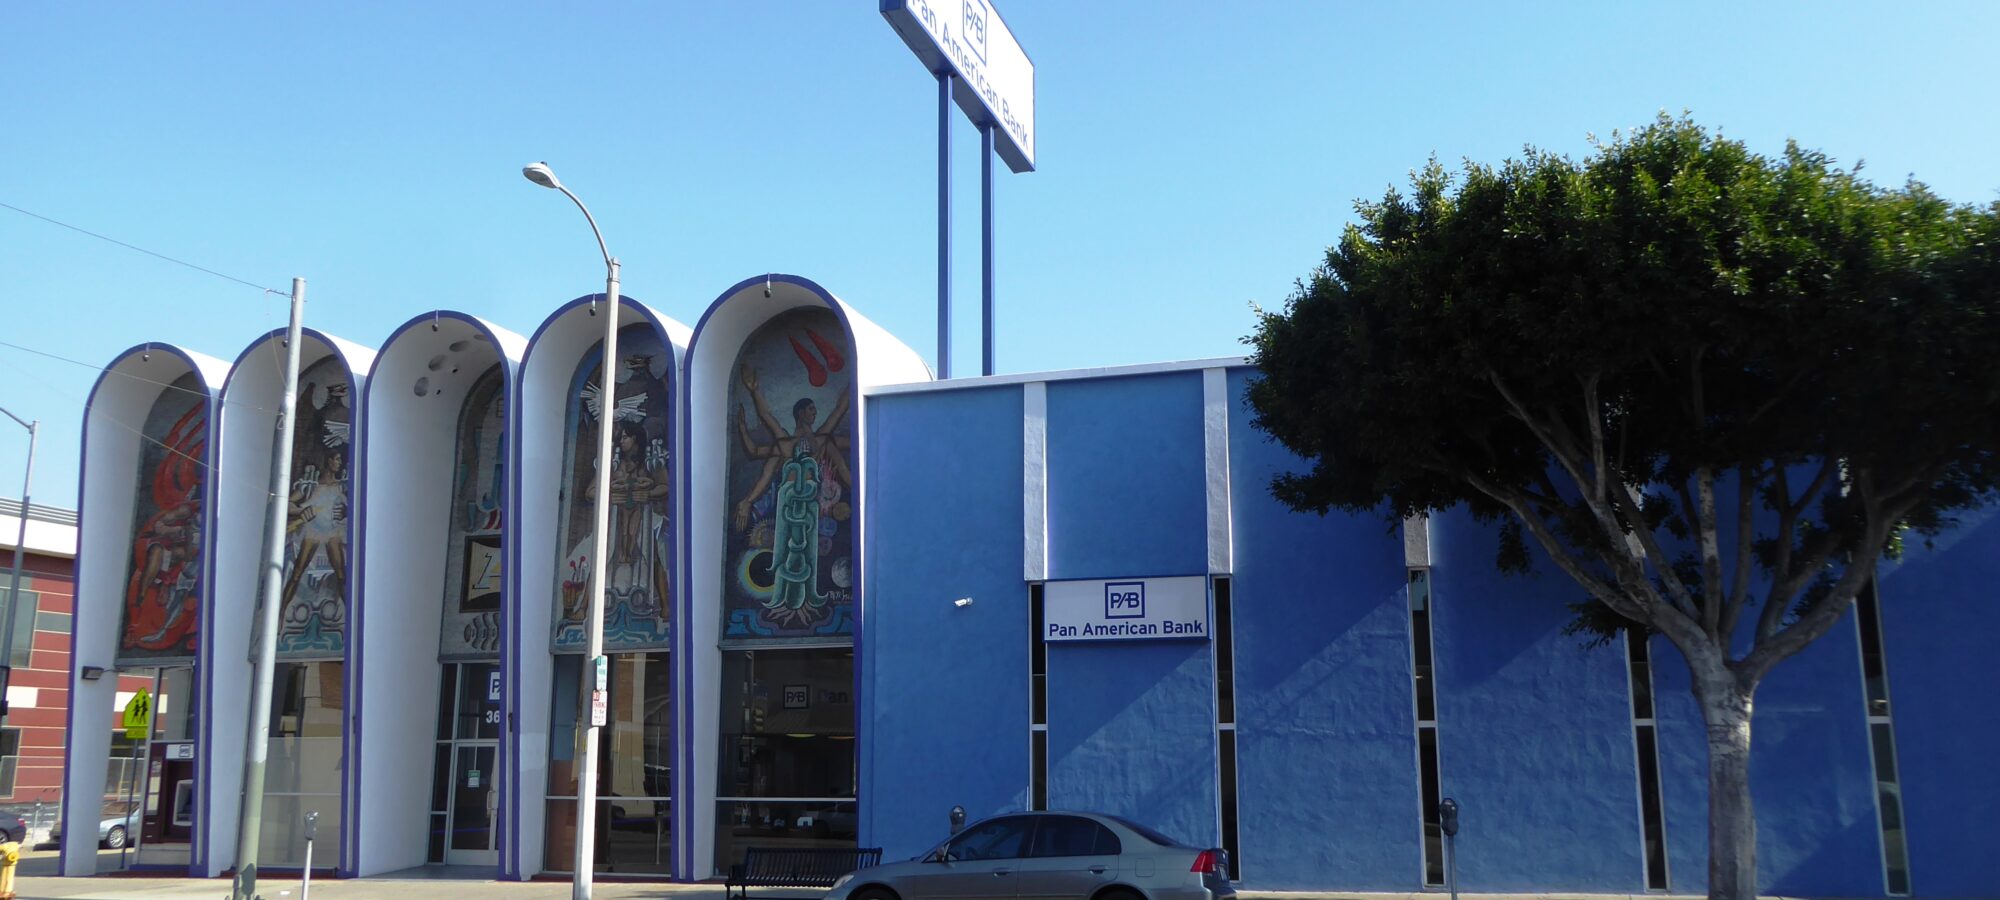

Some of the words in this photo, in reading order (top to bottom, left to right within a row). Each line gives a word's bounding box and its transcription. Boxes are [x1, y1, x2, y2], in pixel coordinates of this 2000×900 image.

[942, 22, 1000, 112] American
[1002, 98, 1029, 150] Bank
[1049, 623, 1077, 637] Pan
[1082, 621, 1157, 637] American
[1163, 620, 1203, 634] Bank
